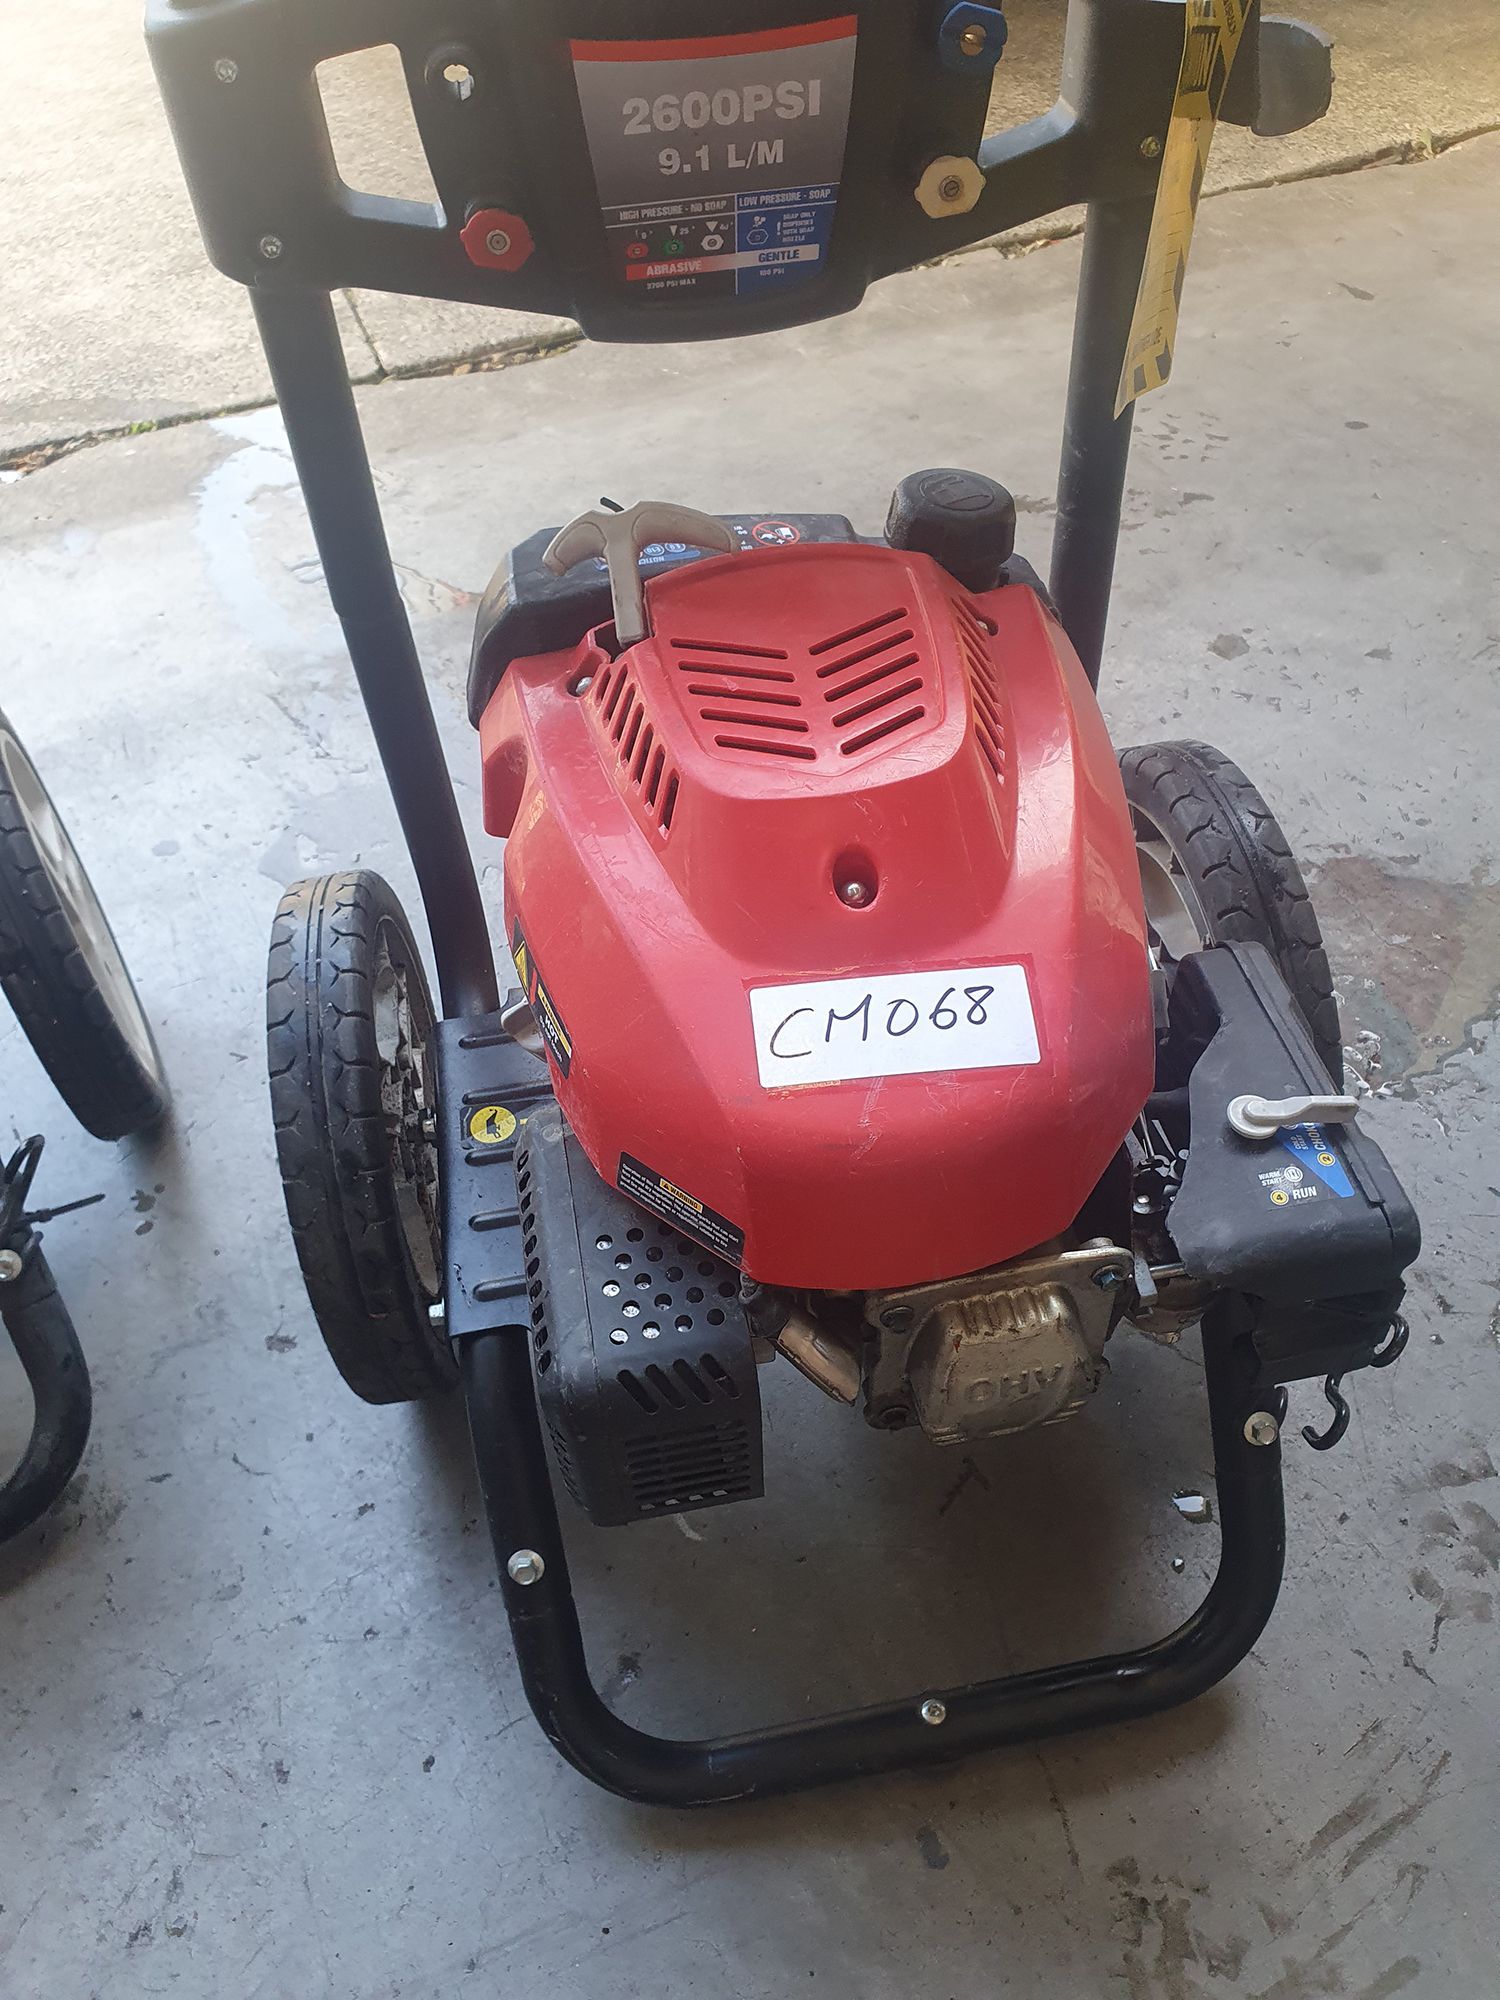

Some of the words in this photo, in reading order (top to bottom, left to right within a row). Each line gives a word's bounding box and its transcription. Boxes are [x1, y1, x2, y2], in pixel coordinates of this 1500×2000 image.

[623, 79, 821, 135] 2600PSI
[658, 145, 710, 175] 9.1
[727, 139, 784, 169] L/M
[739, 196, 759, 207] LOW
[759, 191, 802, 204] PRESSURE
[808, 188, 831, 200] SOAP
[620, 210, 640, 220] HIGH
[641, 205, 684, 218] PRESSURE
[690, 203, 703, 213] NO
[704, 200, 727, 211] SOAP
[758, 249, 800, 263] GENTLE
[646, 260, 702, 277] ABRASIVE
[769, 985, 995, 1059] CM068
[1258, 1170, 1282, 1180] WARM
[1261, 1176, 1285, 1186] START
[1292, 1186, 1317, 1200] RUN
